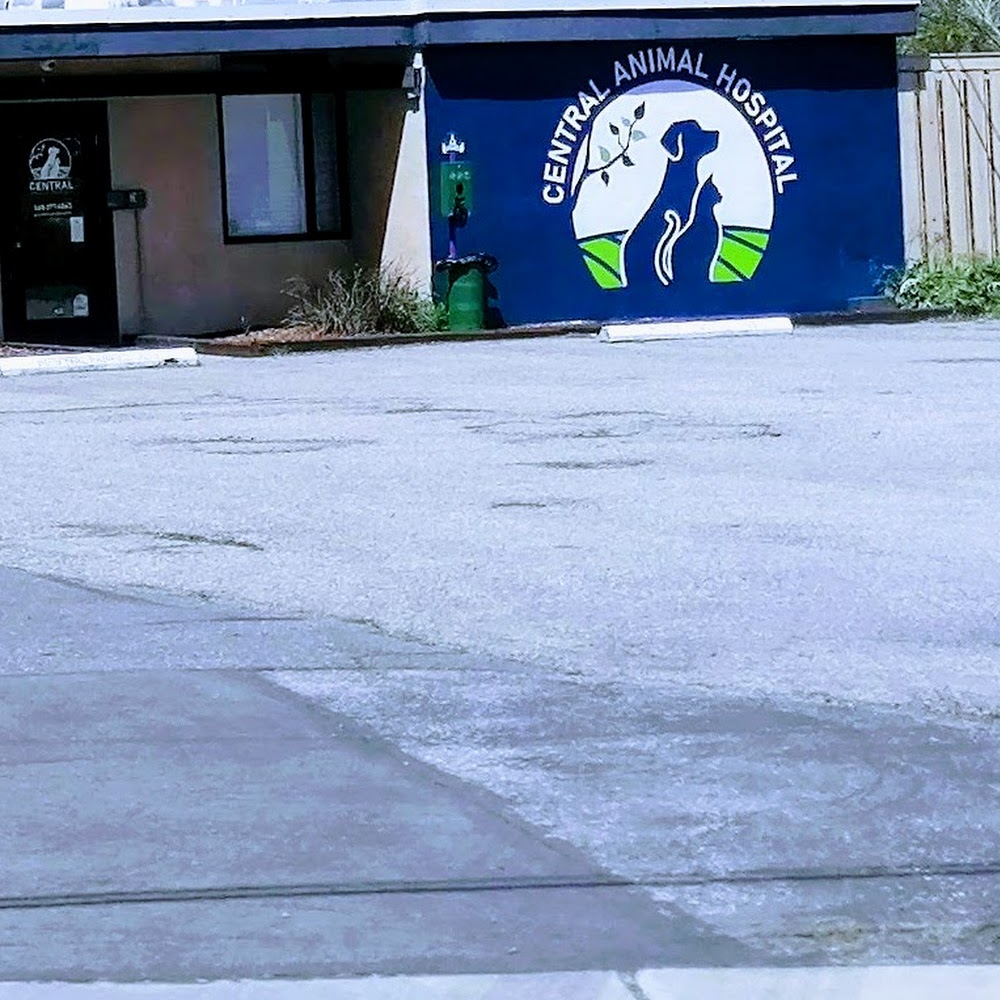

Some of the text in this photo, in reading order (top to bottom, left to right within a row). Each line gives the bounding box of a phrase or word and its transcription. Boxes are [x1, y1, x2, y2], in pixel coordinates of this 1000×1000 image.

[543, 47, 798, 205] CENTRAL ANIMAL HOSPITAL
[29, 180, 74, 191] CENTRAL
